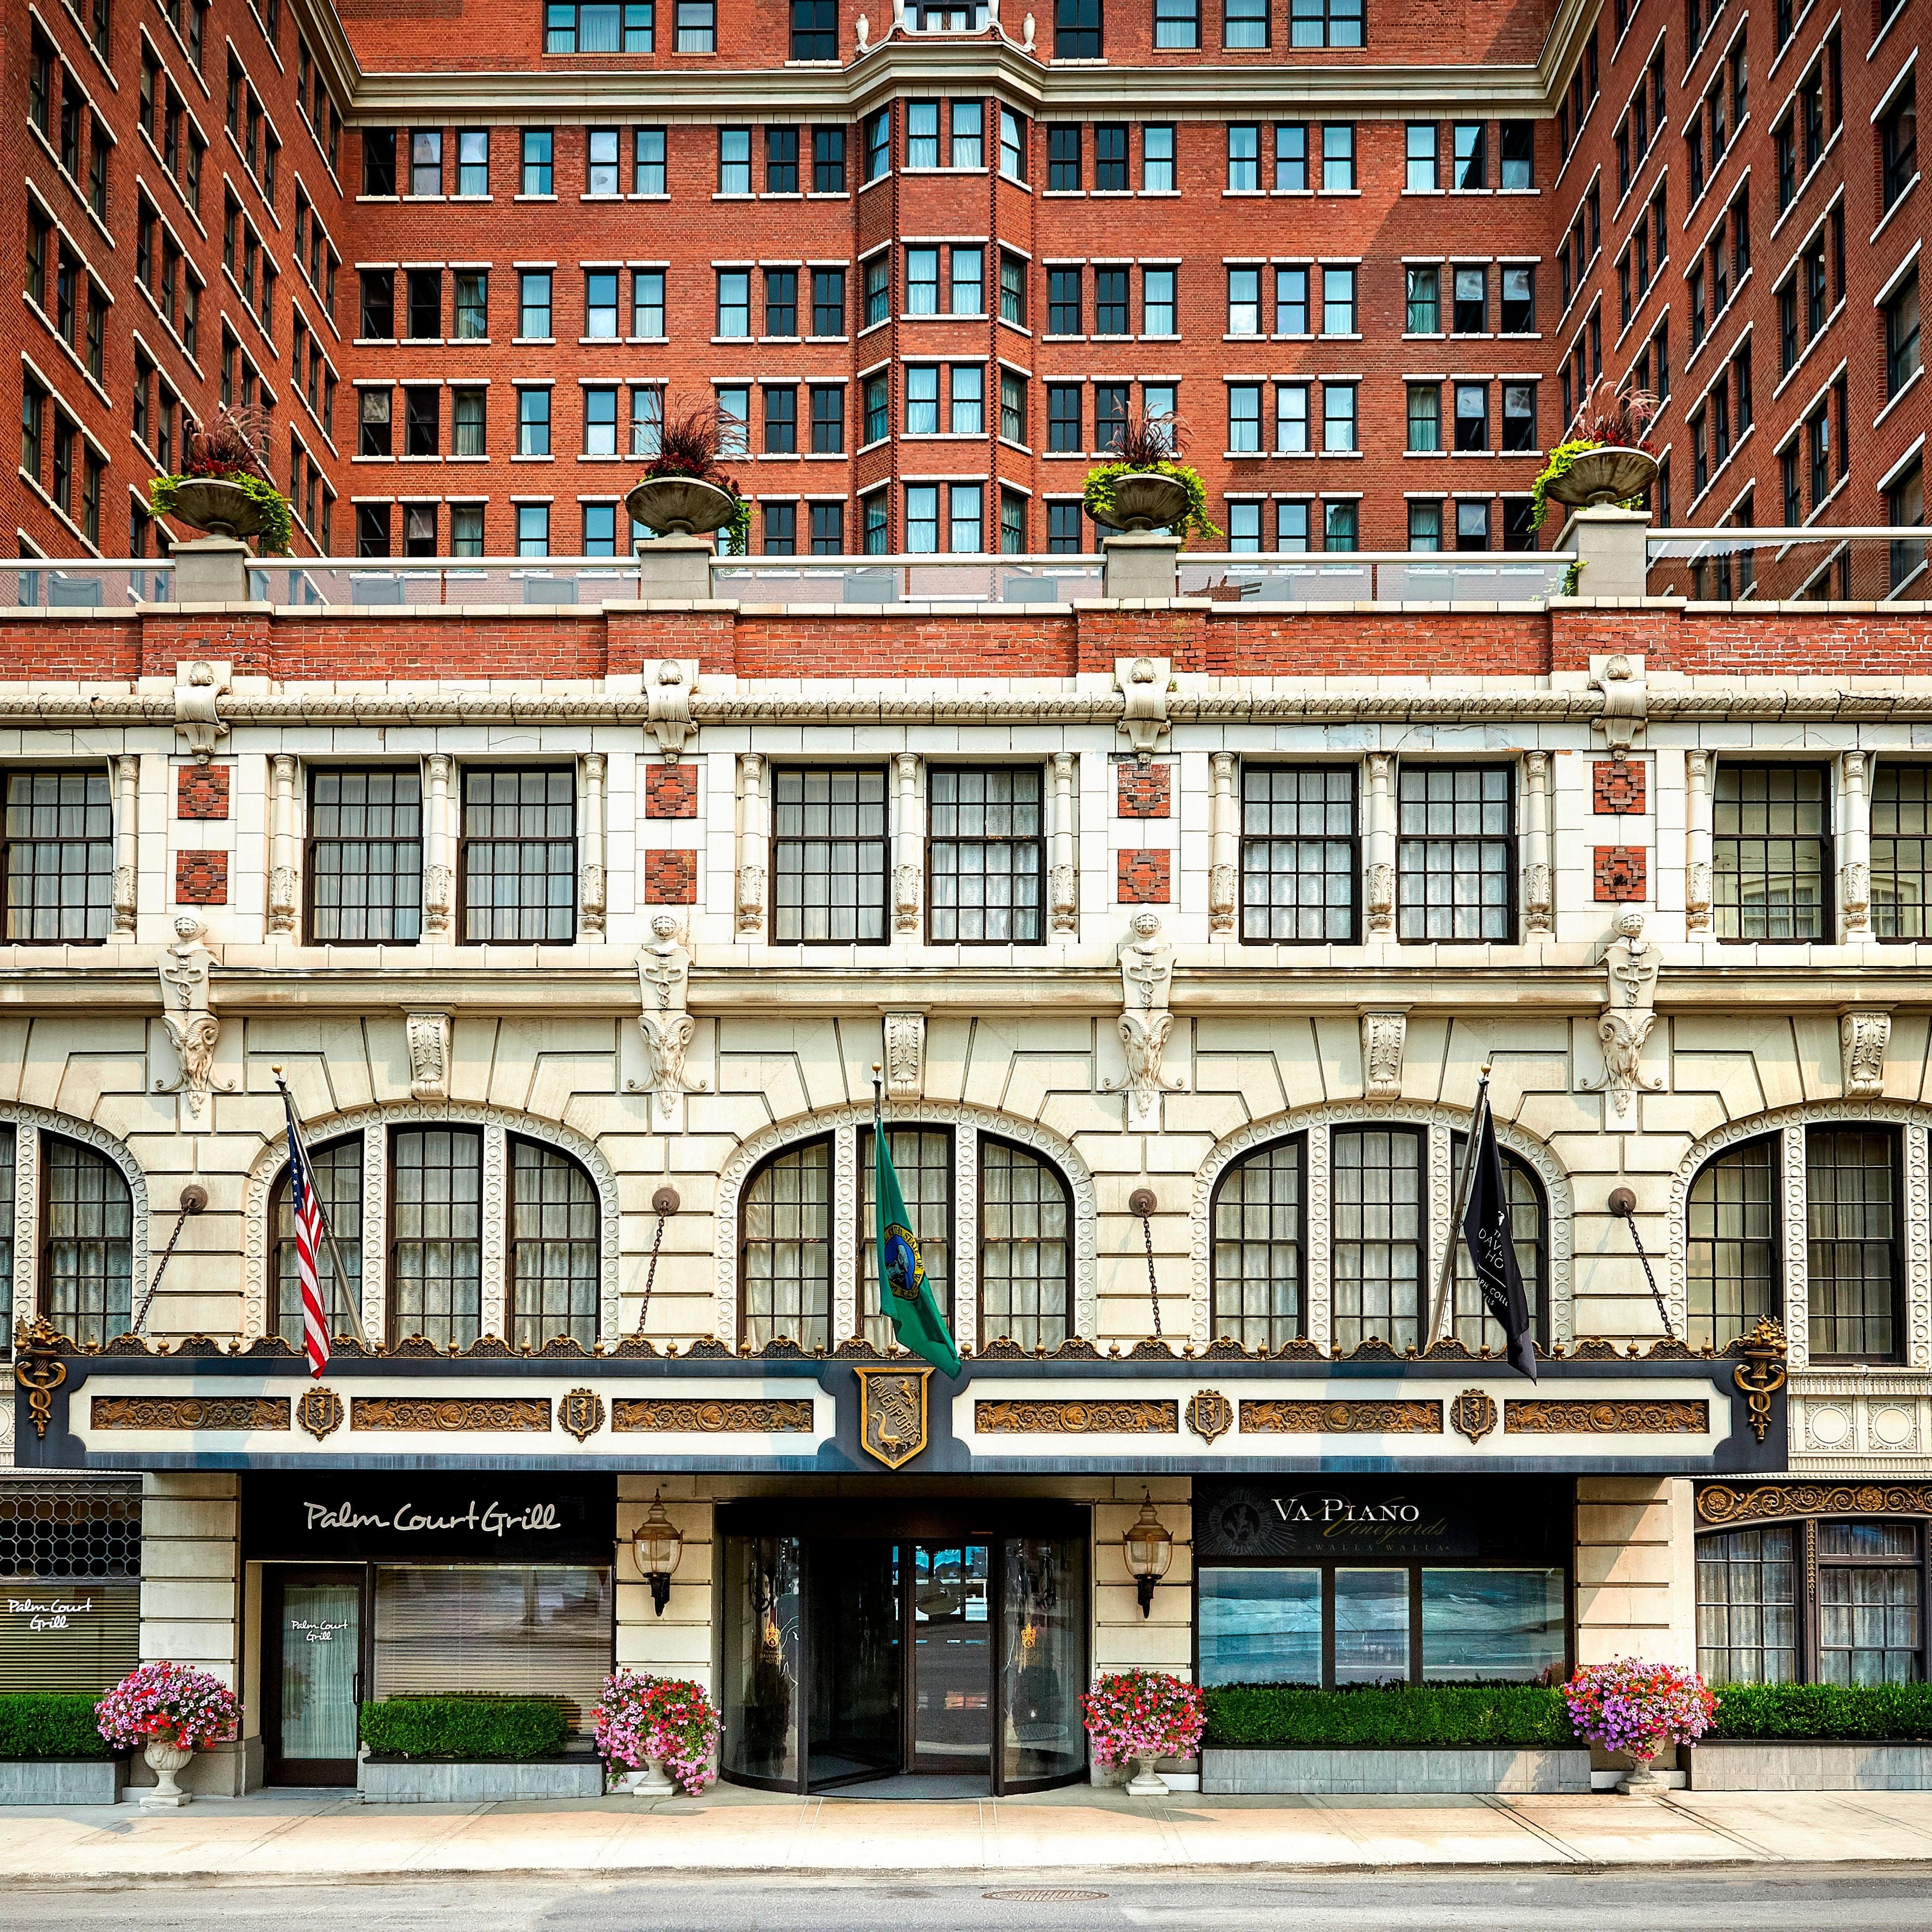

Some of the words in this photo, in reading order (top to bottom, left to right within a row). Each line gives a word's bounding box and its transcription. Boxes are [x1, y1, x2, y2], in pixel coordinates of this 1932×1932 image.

[869, 1376, 921, 1446] DAVENPORTS
[304, 1501, 390, 1530] Palm
[393, 1500, 480, 1531] Court
[481, 1501, 561, 1537] Grill
[1284, 1490, 1448, 1545] Vineyards
[1315, 1544, 1373, 1552] WALLA
[1385, 1544, 1444, 1552] WALLA
[7, 1598, 50, 1613] Palm
[50, 1597, 93, 1614] Court
[30, 1613, 69, 1632] Grill
[291, 1619, 319, 1630] Palm
[320, 1619, 348, 1631] Court
[306, 1630, 333, 1642] Grill
